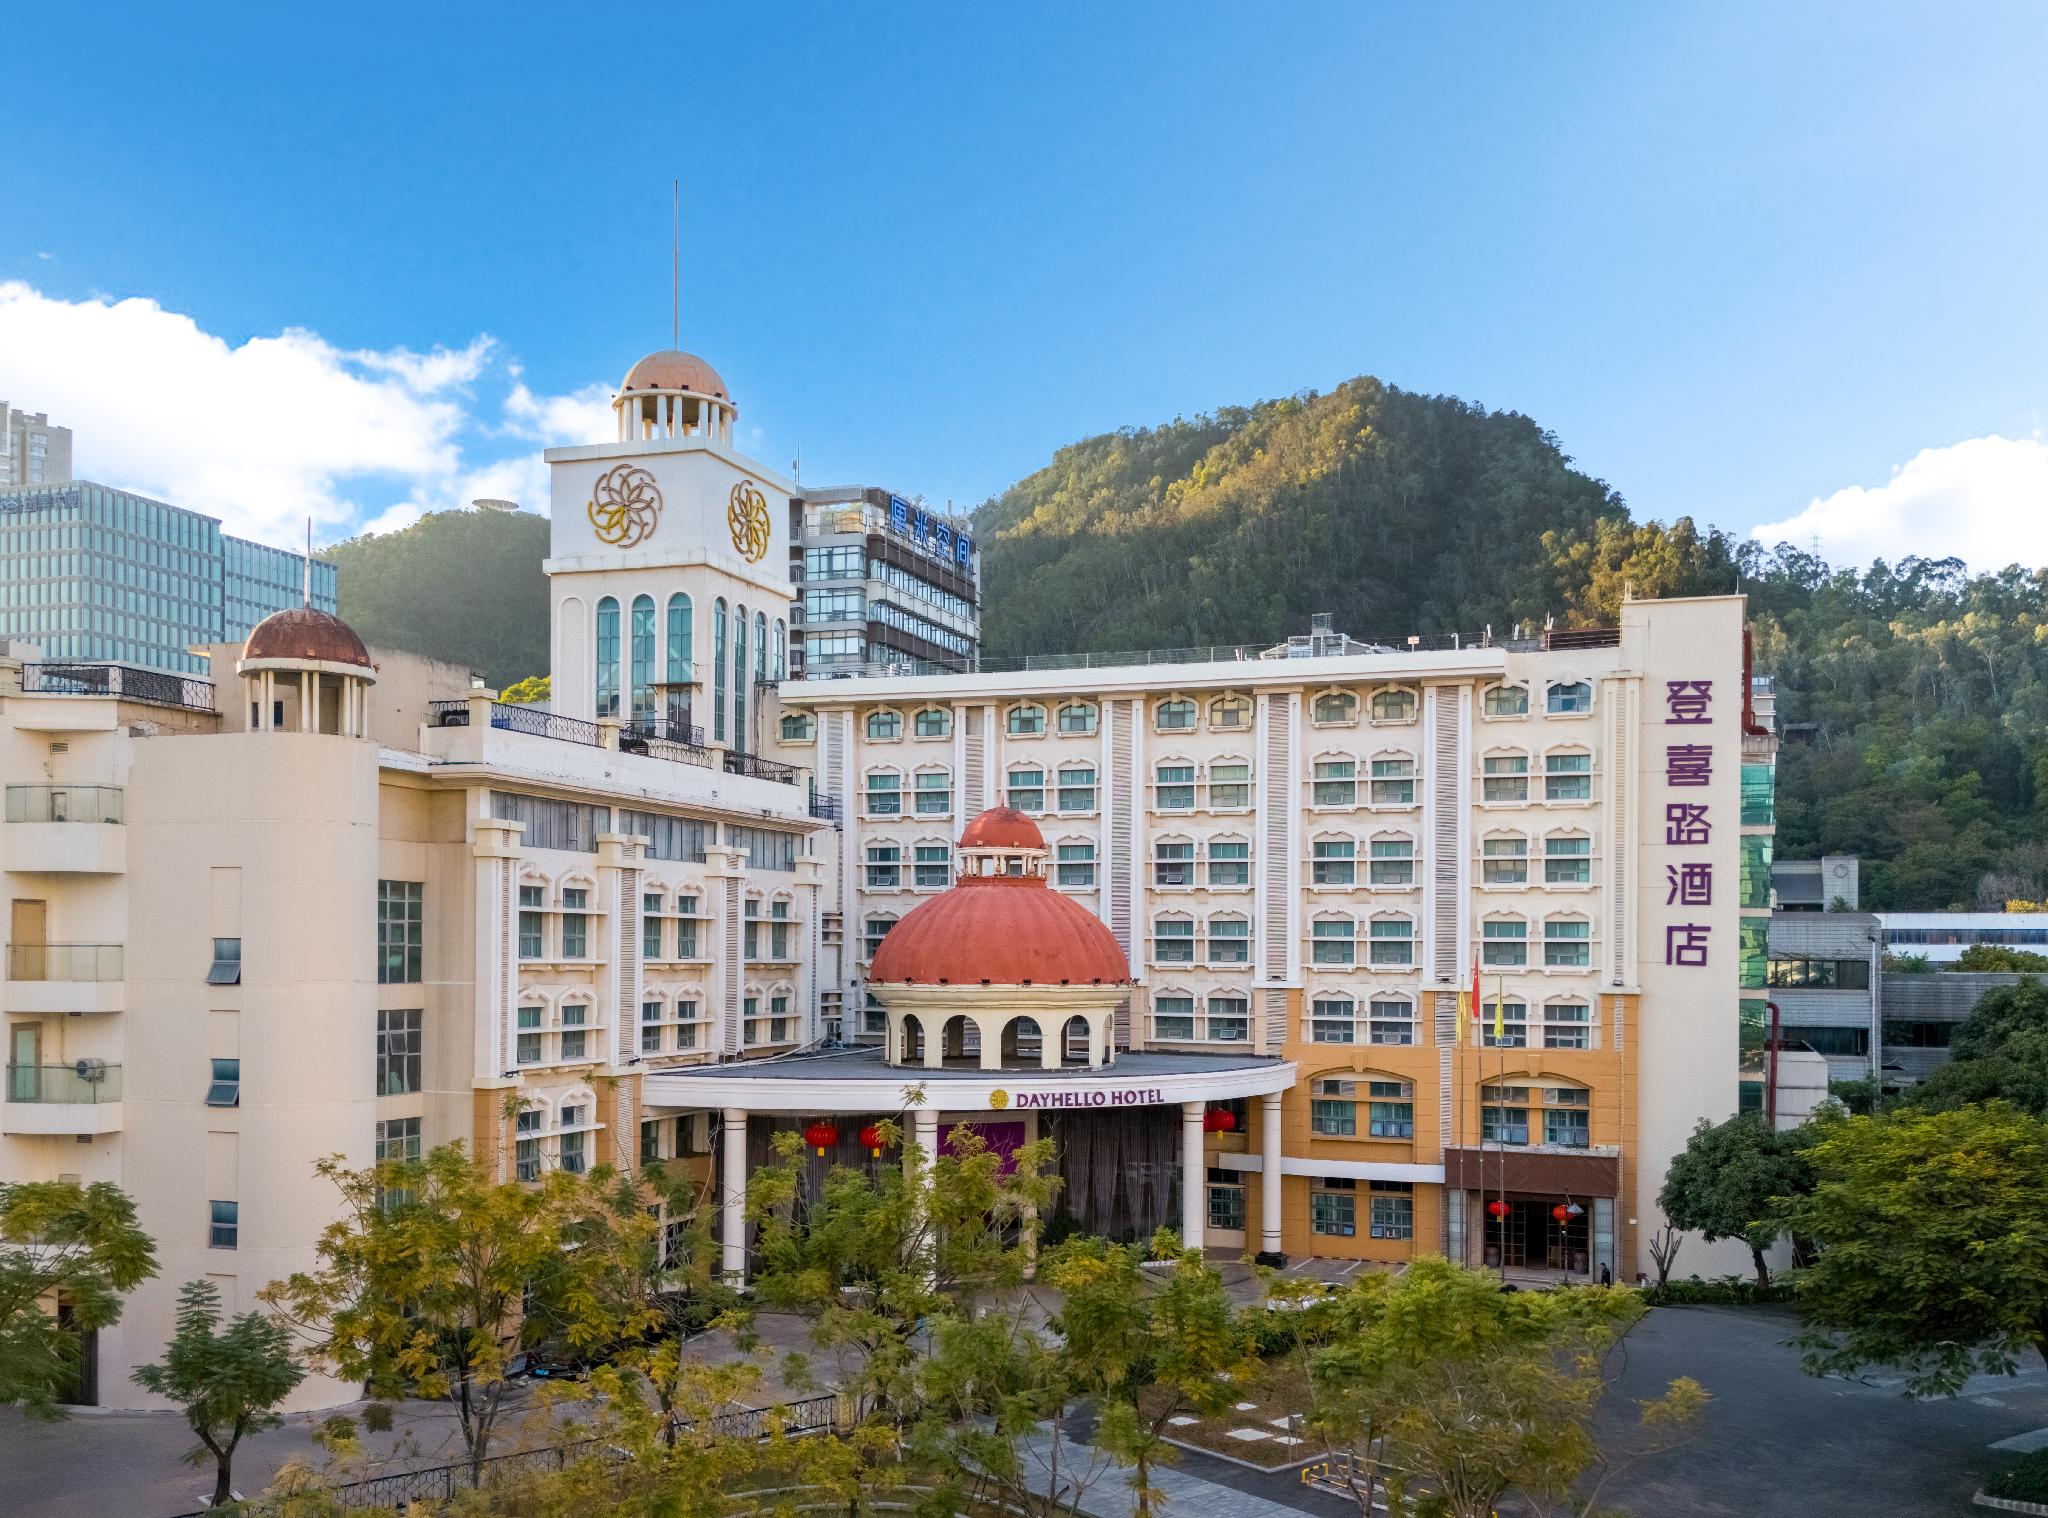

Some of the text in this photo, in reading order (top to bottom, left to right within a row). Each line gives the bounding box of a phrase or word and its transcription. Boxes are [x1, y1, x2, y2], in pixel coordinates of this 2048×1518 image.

[1665, 681, 1713, 966] 登喜路酒店
[1016, 1089, 1164, 1107] DAYHELLO HOTEL
